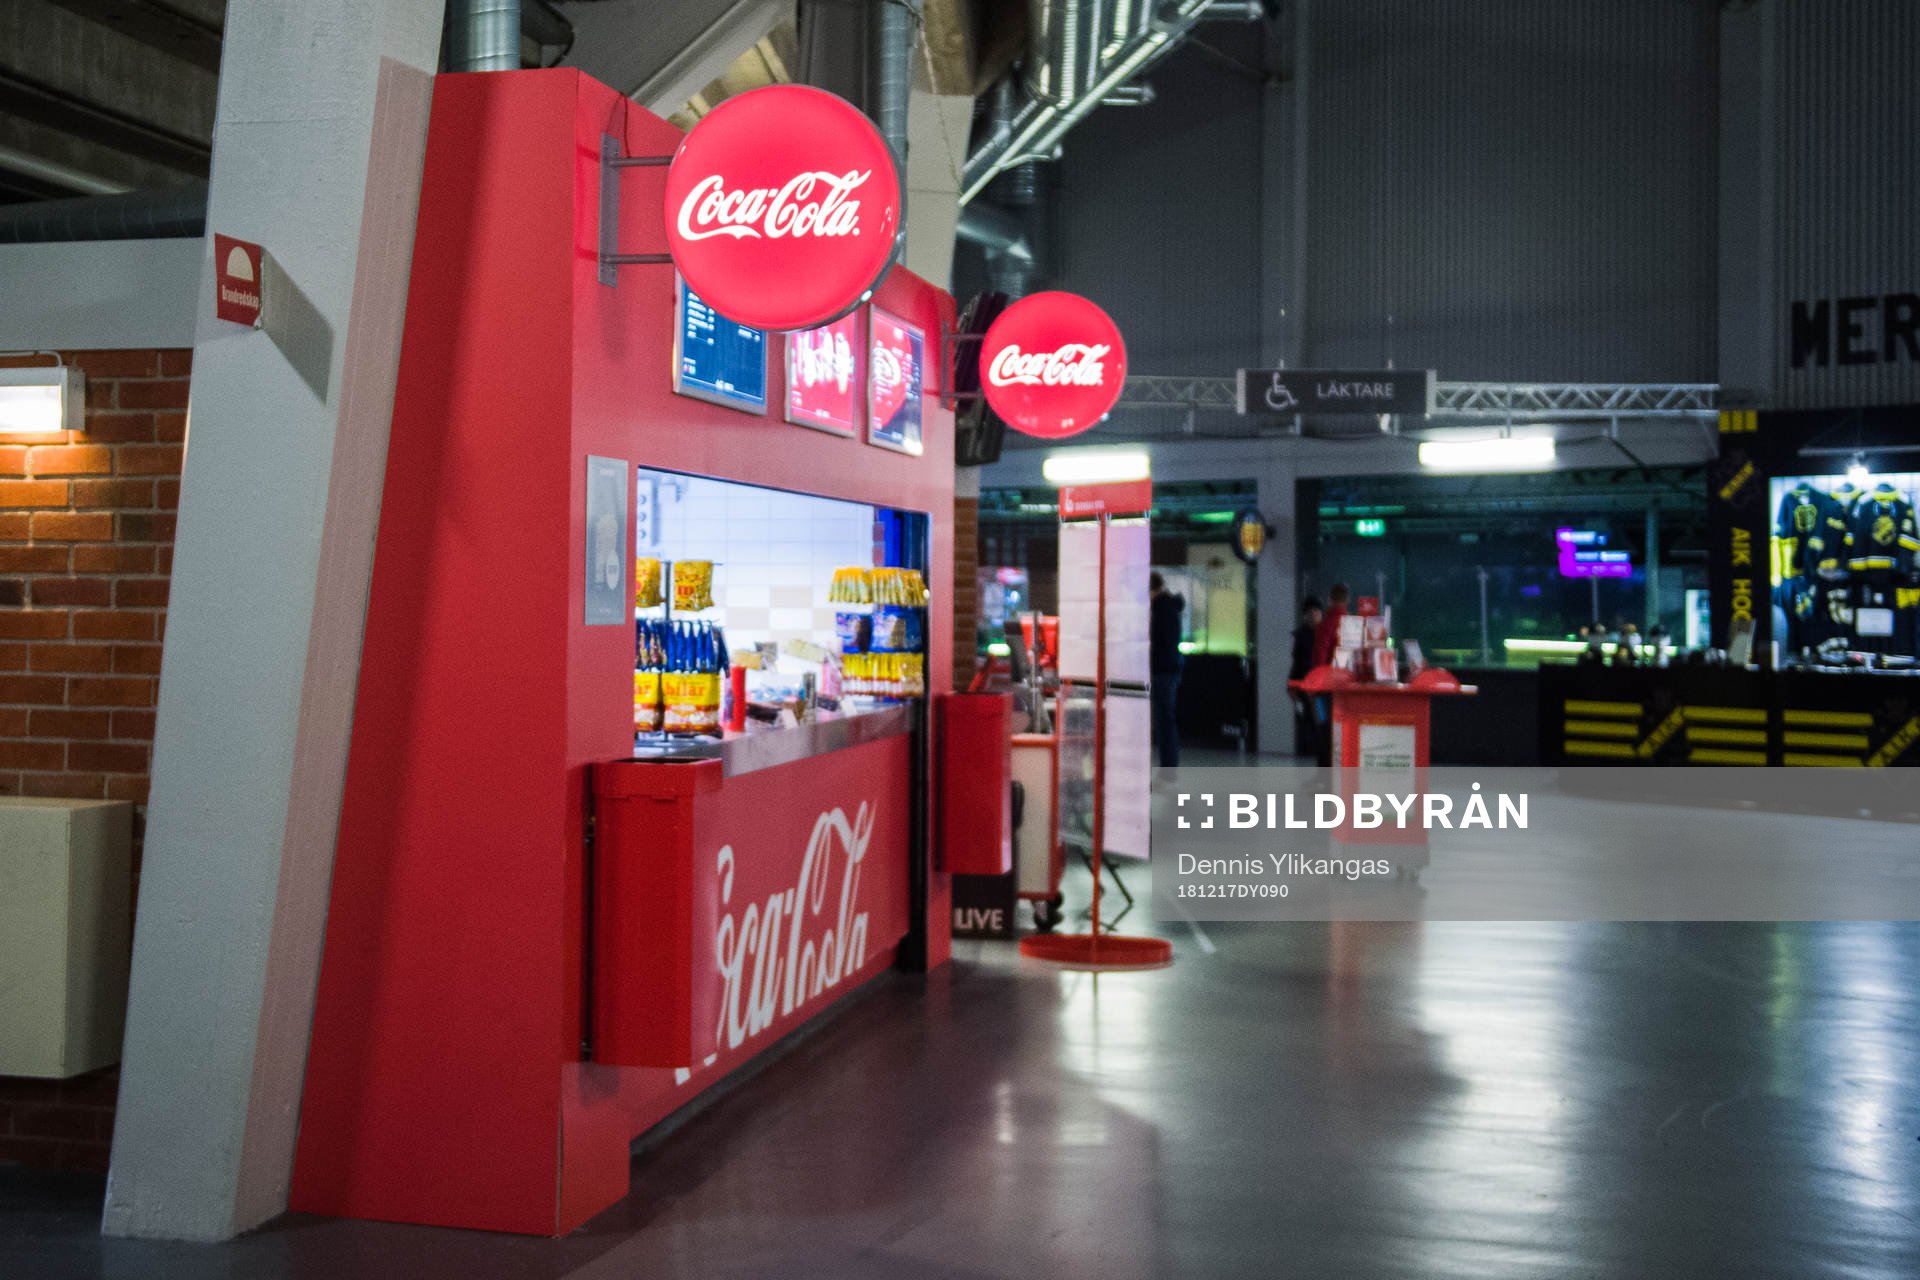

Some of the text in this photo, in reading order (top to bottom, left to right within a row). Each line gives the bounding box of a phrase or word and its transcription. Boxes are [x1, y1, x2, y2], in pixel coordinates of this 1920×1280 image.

[1790, 292, 1920, 369] MER
[1317, 379, 1394, 399] LÄKTARE
[1731, 526, 1752, 567] AIK
[665, 681, 706, 697] bilar
